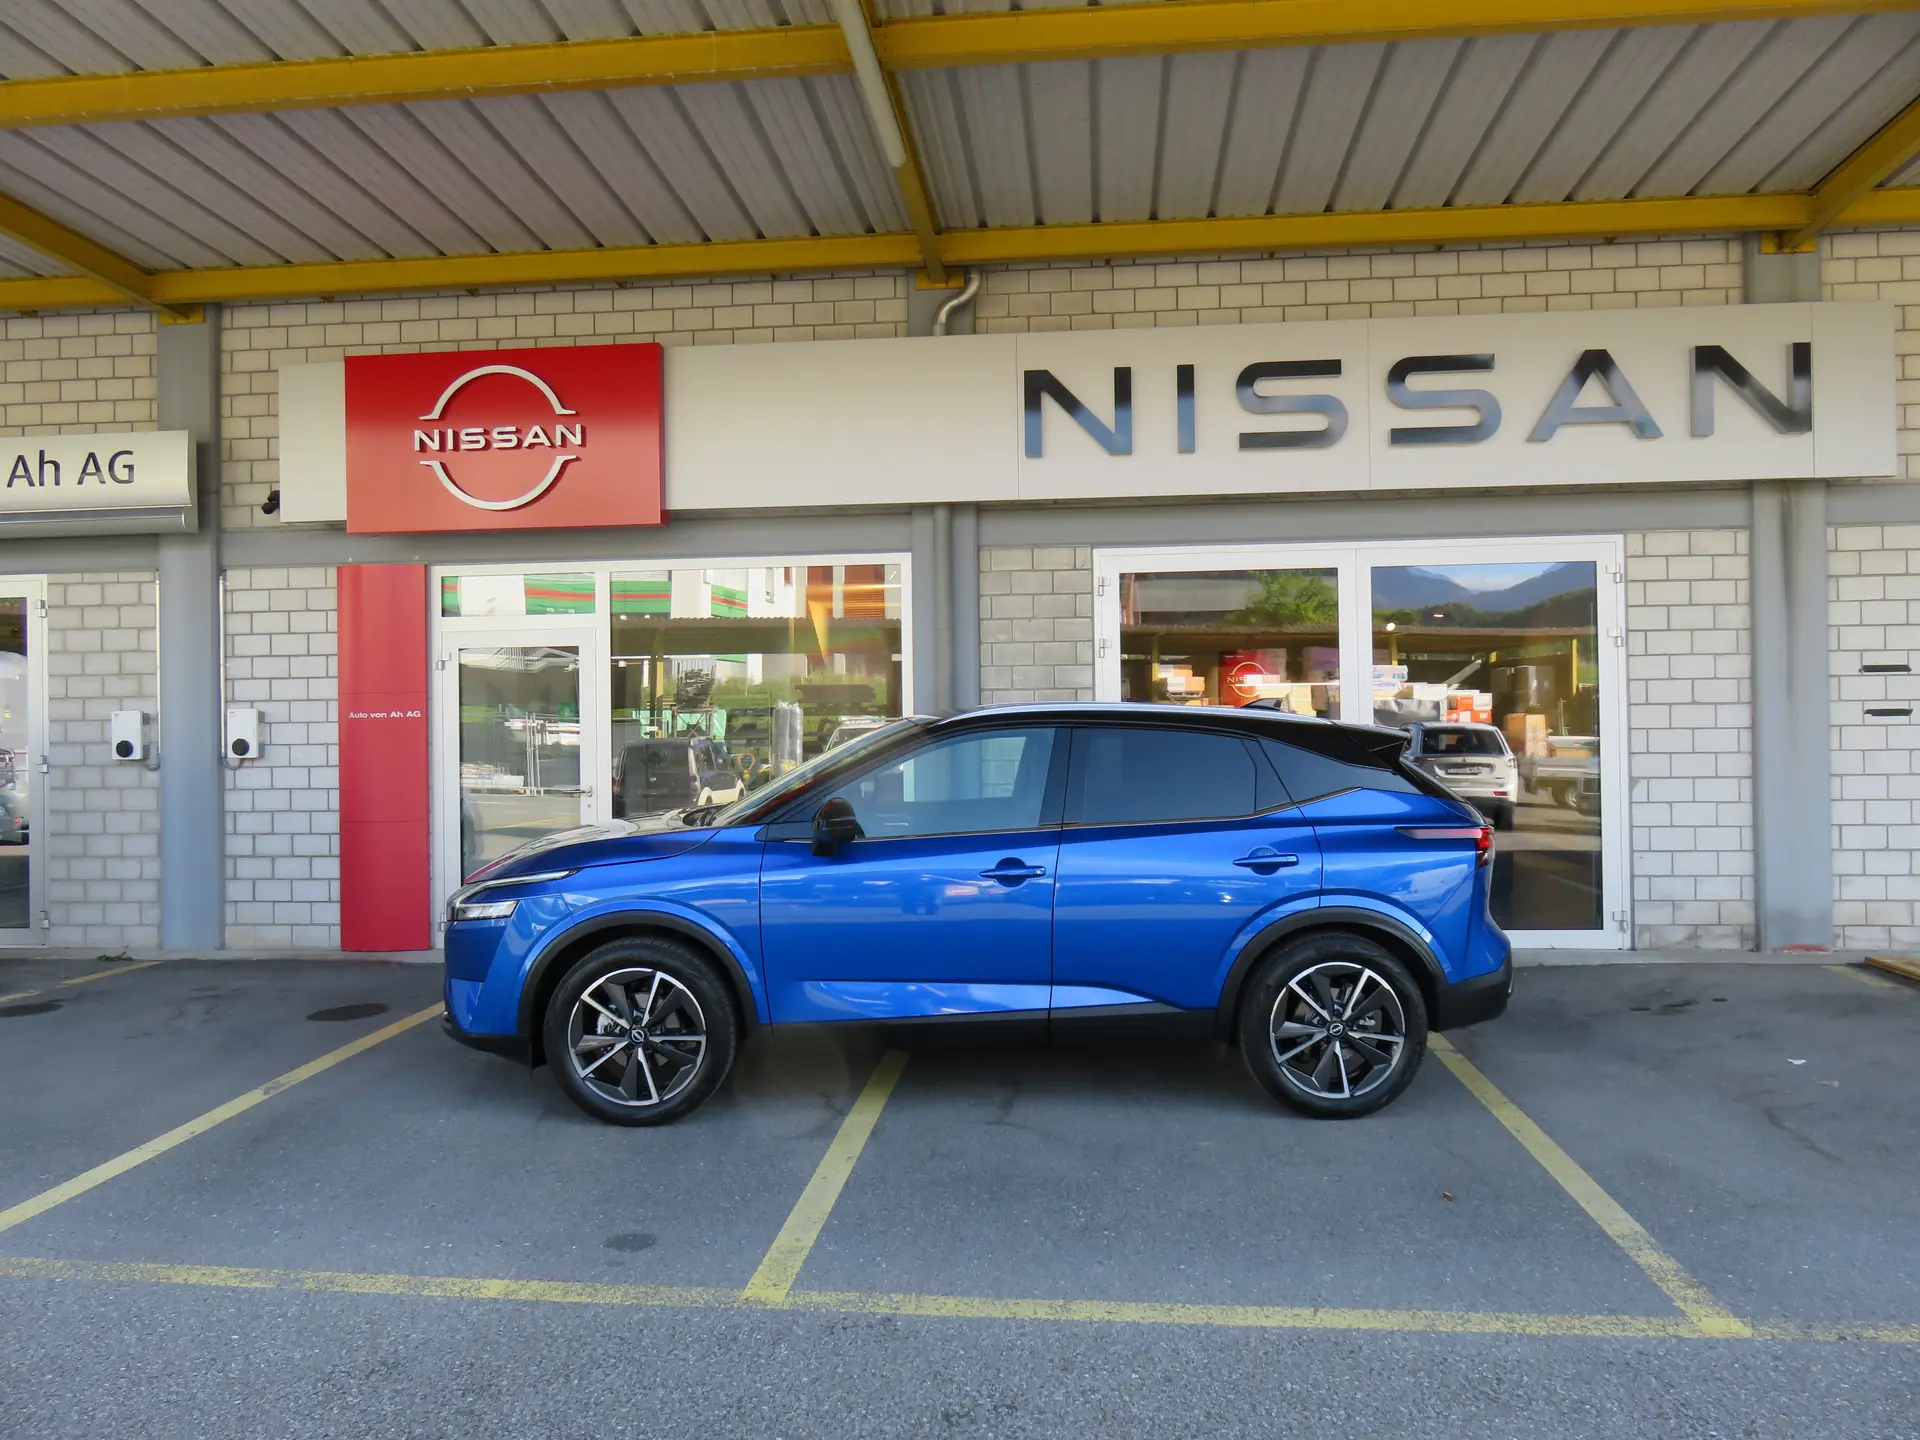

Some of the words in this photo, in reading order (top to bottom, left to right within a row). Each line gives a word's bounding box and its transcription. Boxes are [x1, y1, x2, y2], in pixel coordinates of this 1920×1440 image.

[1023, 341, 1813, 459] NISSAN
[414, 423, 582, 451] NISSAN
[6, 449, 62, 488] Ah
[76, 449, 136, 487] AG
[406, 710, 421, 718] AG
